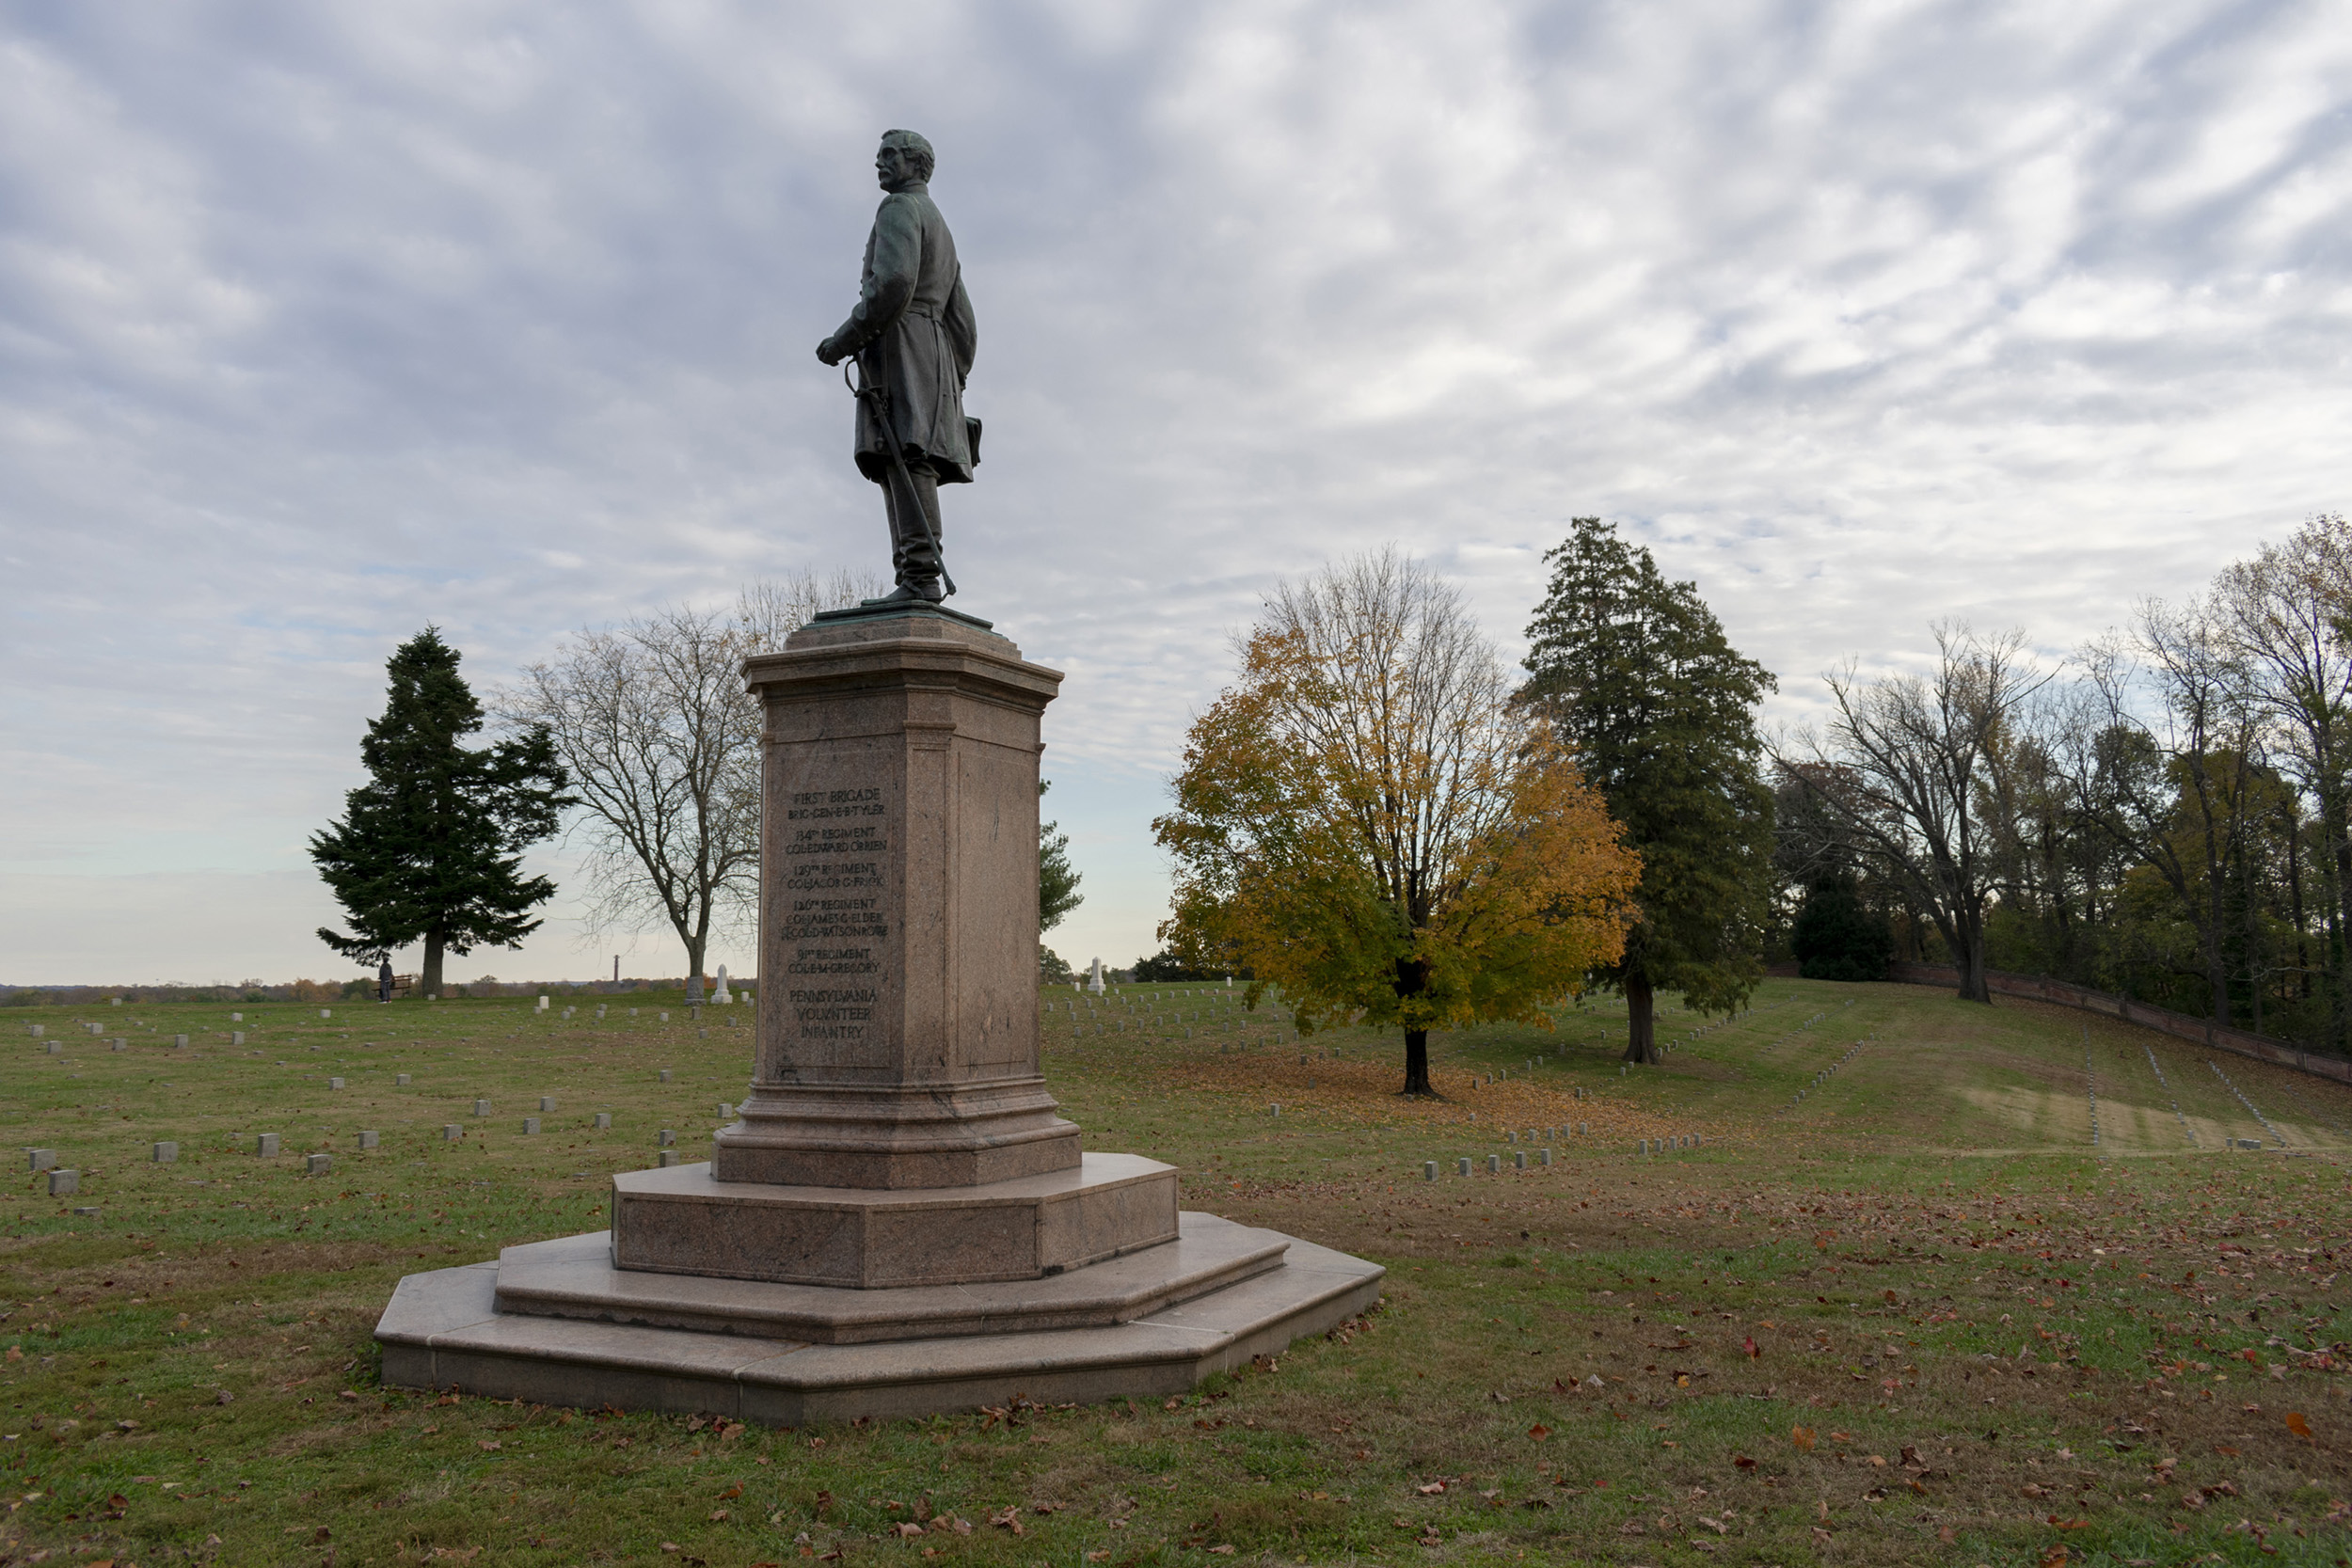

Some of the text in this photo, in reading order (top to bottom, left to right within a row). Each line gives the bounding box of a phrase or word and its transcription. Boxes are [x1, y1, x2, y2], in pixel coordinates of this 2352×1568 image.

[795, 788, 881, 804] FIRST BRIGADE
[822, 827, 876, 839] REGIMENT
[822, 863, 877, 875] REGIMENT
[820, 898, 876, 911] REGIMENT
[817, 948, 871, 959] REGIMENT
[789, 989, 878, 1003] PENNSYLVANIA
[802, 1025, 864, 1038] INFANTRY
